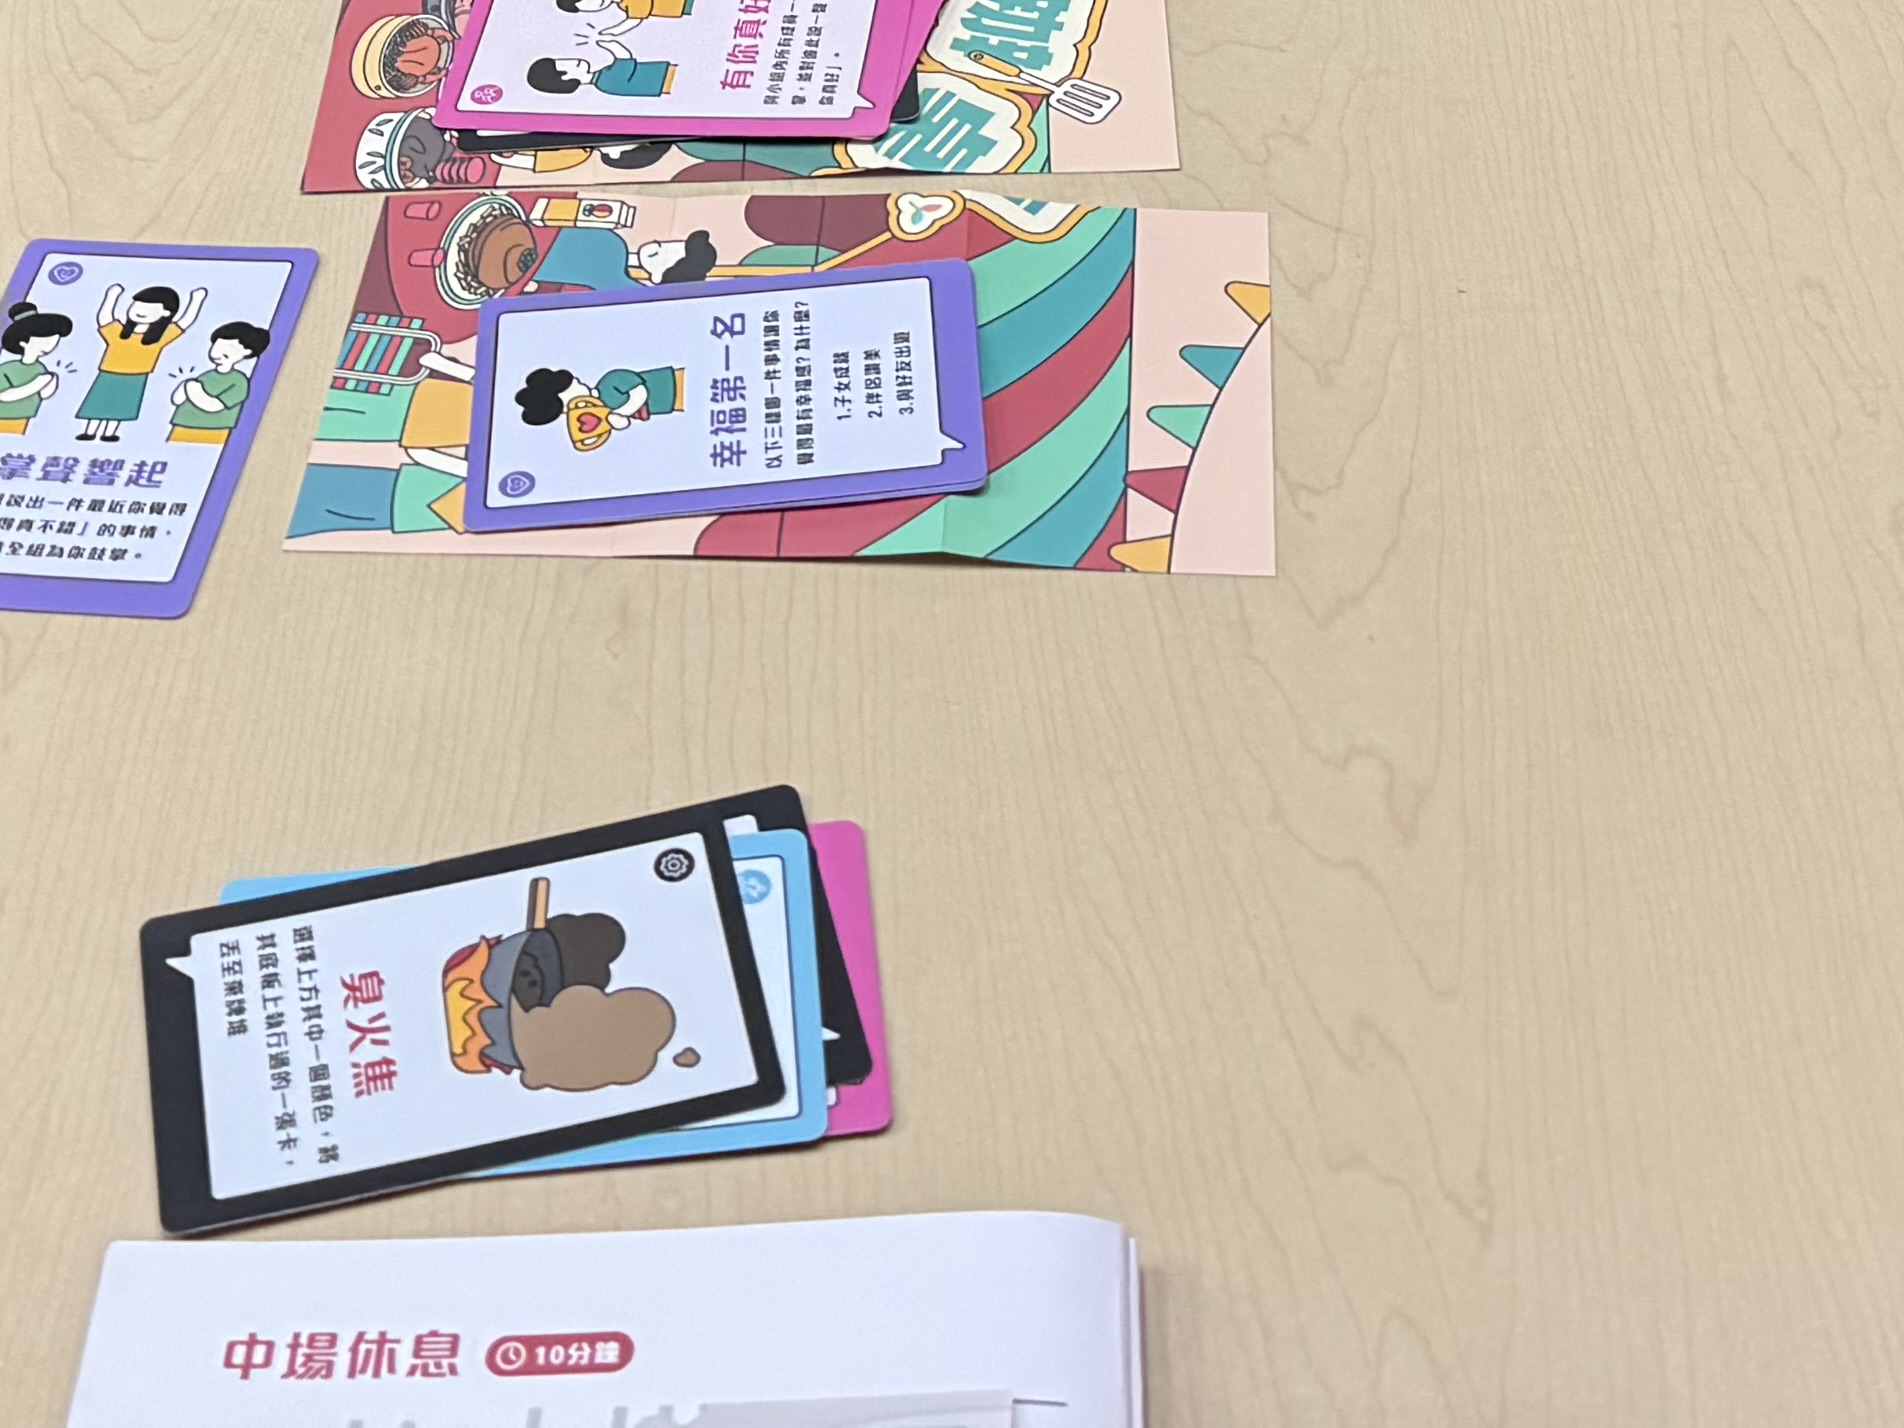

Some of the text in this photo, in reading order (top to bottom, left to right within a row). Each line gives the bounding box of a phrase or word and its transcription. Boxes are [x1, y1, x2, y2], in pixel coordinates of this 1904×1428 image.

[709, 312, 747, 469] 幸福第一名
[339, 969, 401, 1099] 臭火焦
[222, 1330, 462, 1382] 中場休息
[534, 1339, 621, 1371] 10分鐘
